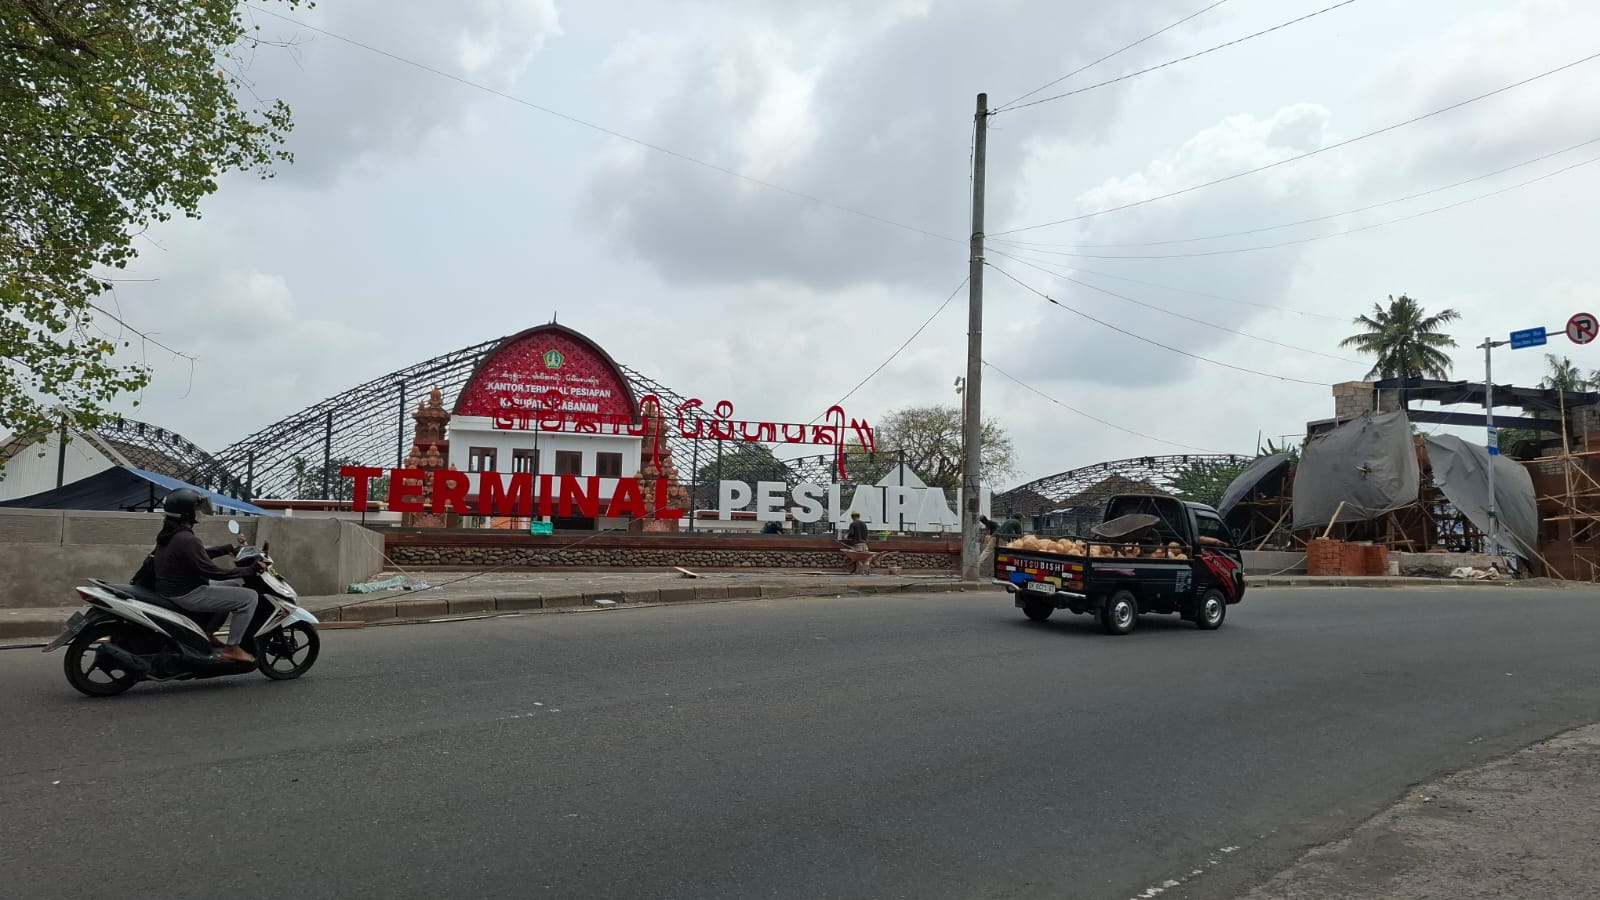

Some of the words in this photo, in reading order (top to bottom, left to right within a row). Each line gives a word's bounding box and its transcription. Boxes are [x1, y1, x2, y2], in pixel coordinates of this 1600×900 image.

[488, 383, 525, 393] KANTOR
[570, 387, 611, 398] PESIAPAN
[557, 400, 599, 413] ABANAN
[340, 466, 684, 519] TERMINAL
[1014, 558, 1065, 572] MITSUBISHI
